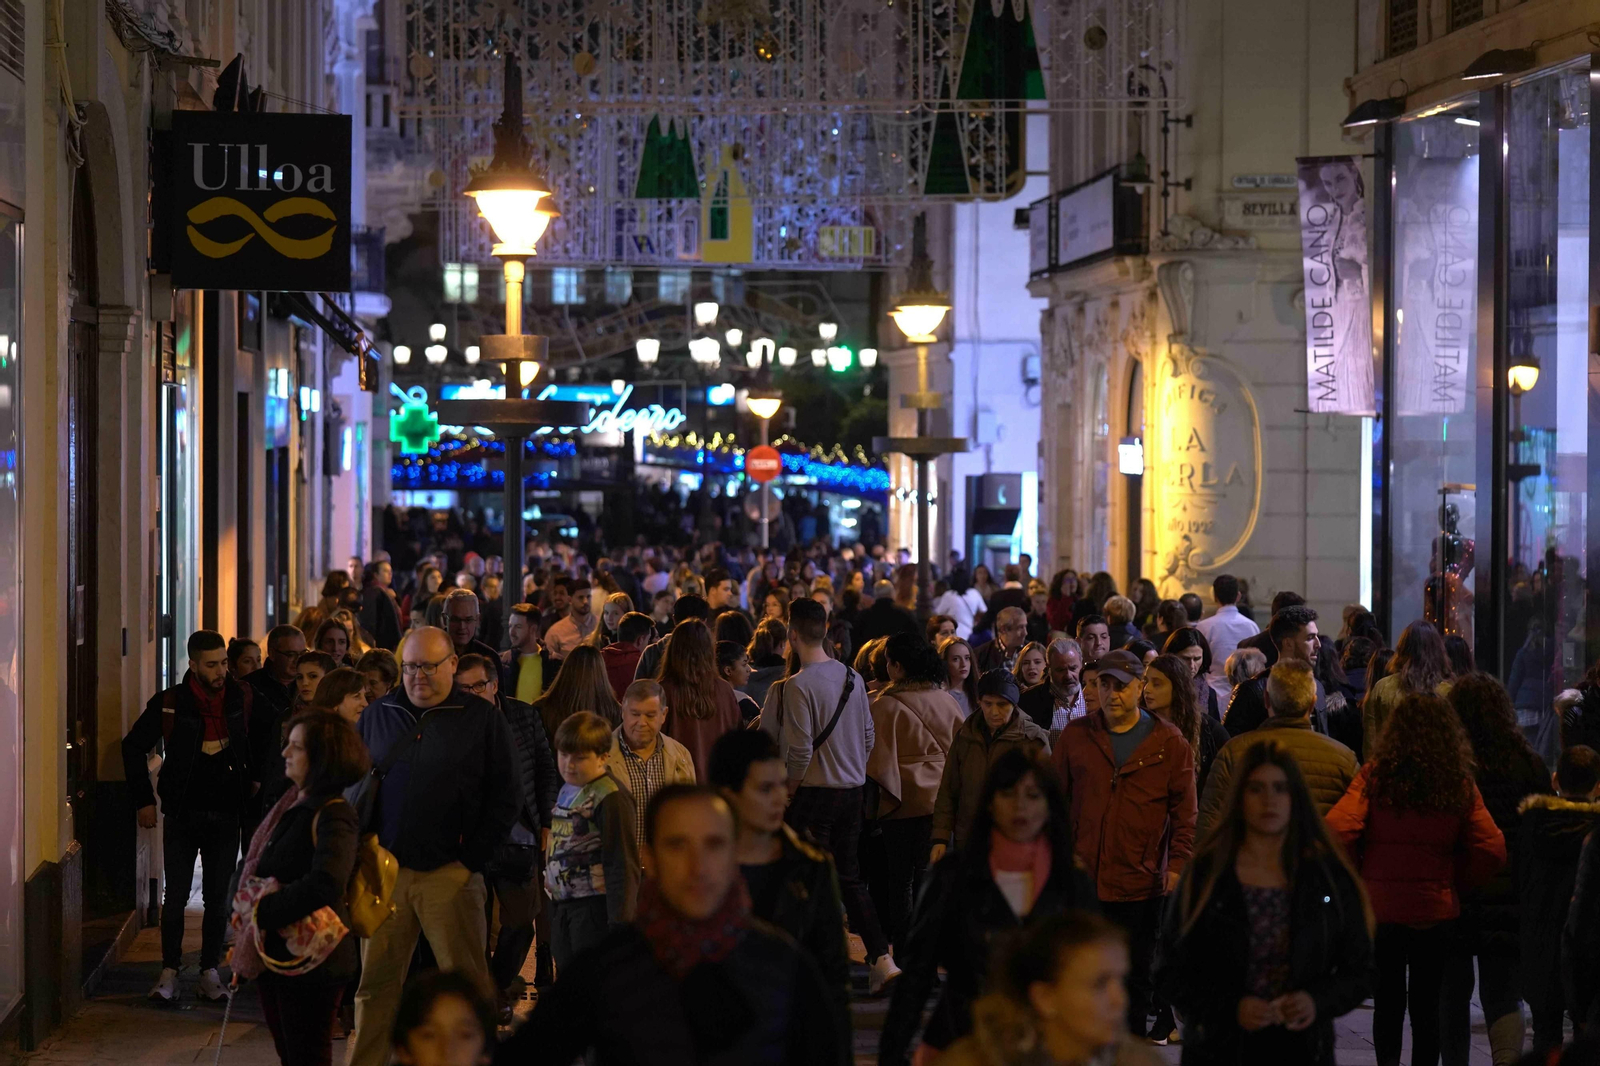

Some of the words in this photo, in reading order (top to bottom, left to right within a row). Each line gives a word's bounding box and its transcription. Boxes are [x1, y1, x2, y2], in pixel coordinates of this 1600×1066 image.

[187, 143, 336, 193] Ulloa
[1242, 203, 1297, 216] SEVILLA
[1307, 204, 1331, 286] CANO
[1311, 297, 1337, 401] MATILDE
[1164, 461, 1245, 493] RLA
